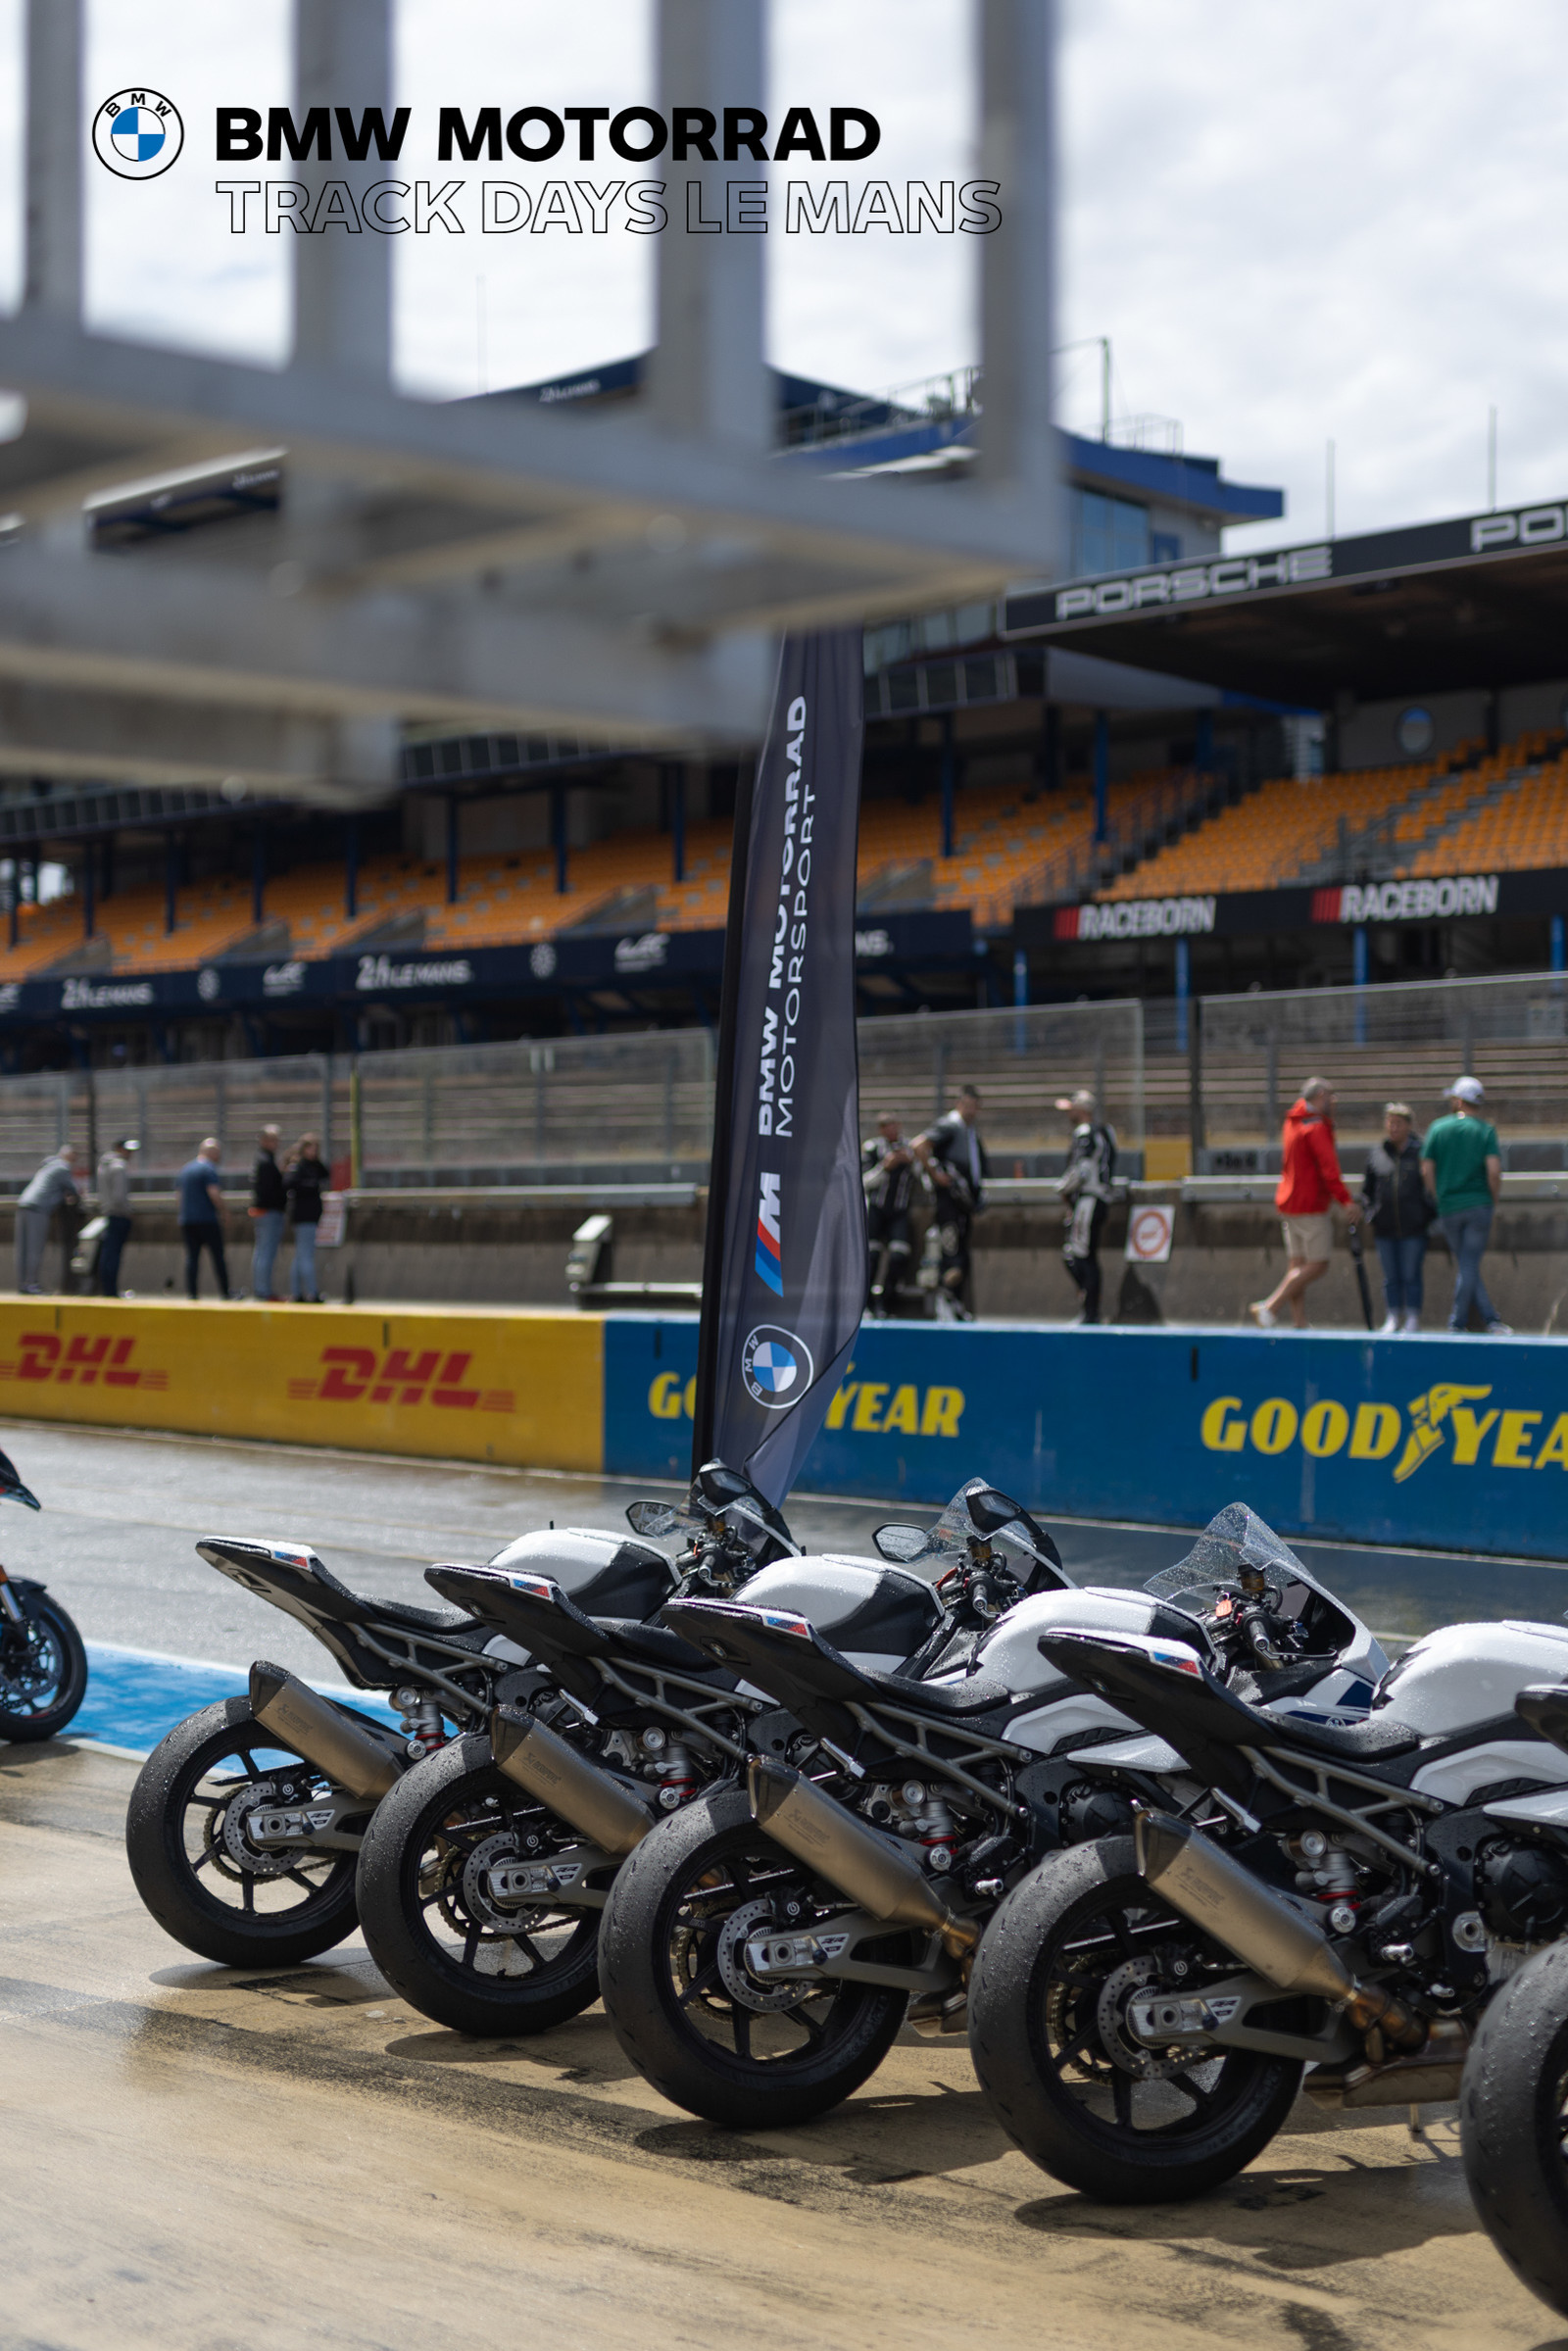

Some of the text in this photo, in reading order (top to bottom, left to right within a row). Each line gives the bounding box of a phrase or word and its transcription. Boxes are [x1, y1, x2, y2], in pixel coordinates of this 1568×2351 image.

[1055, 545, 1333, 621] PORSCHE
[1078, 896, 1216, 941] RACEBORN
[1340, 875, 1499, 924] RACEBORN
[775, 784, 816, 1138] MOTORSPORT
[759, 1005, 779, 1137] BMW
[17, 1333, 142, 1388] DHL
[318, 1347, 481, 1409] DHL
